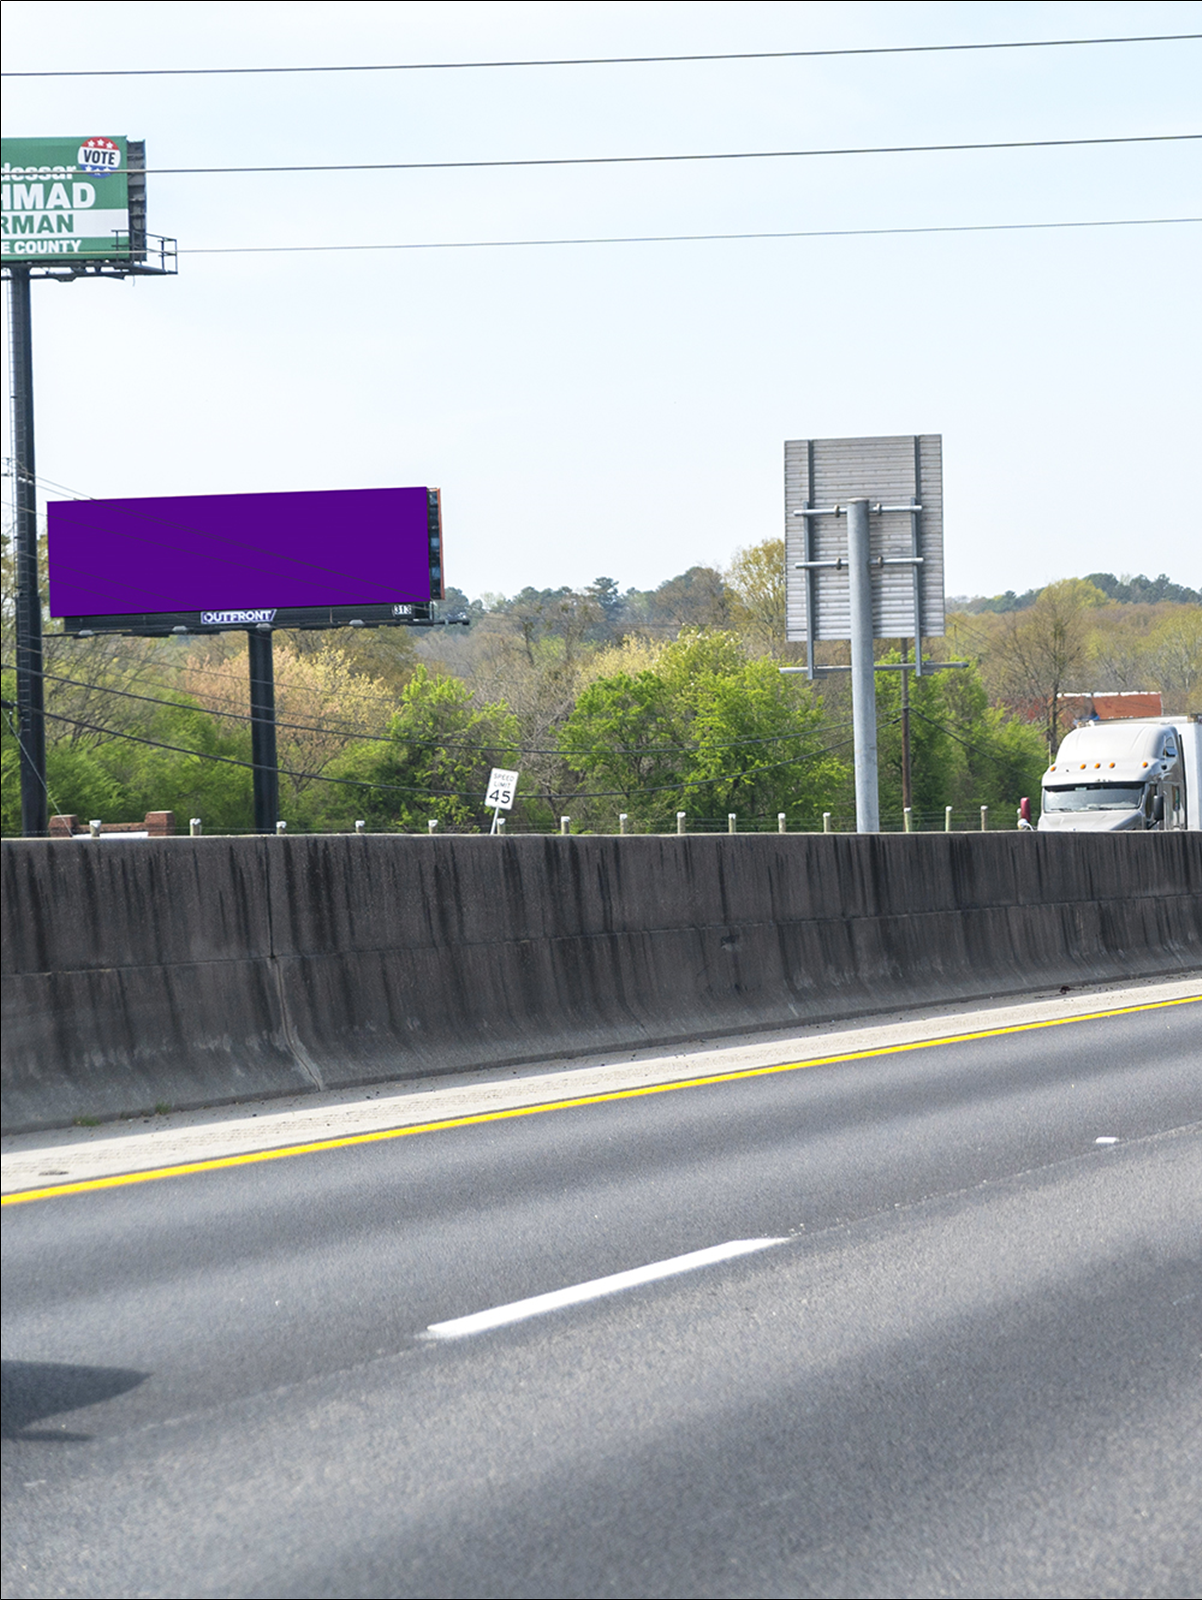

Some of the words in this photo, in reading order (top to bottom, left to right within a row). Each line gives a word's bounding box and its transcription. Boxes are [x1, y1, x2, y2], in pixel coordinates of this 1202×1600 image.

[83, 149, 116, 166] VOTE
[14, 239, 82, 254] COUNTY
[203, 610, 273, 623] OUTFRONT
[494, 773, 514, 781] SPEED
[489, 789, 511, 804] 45
